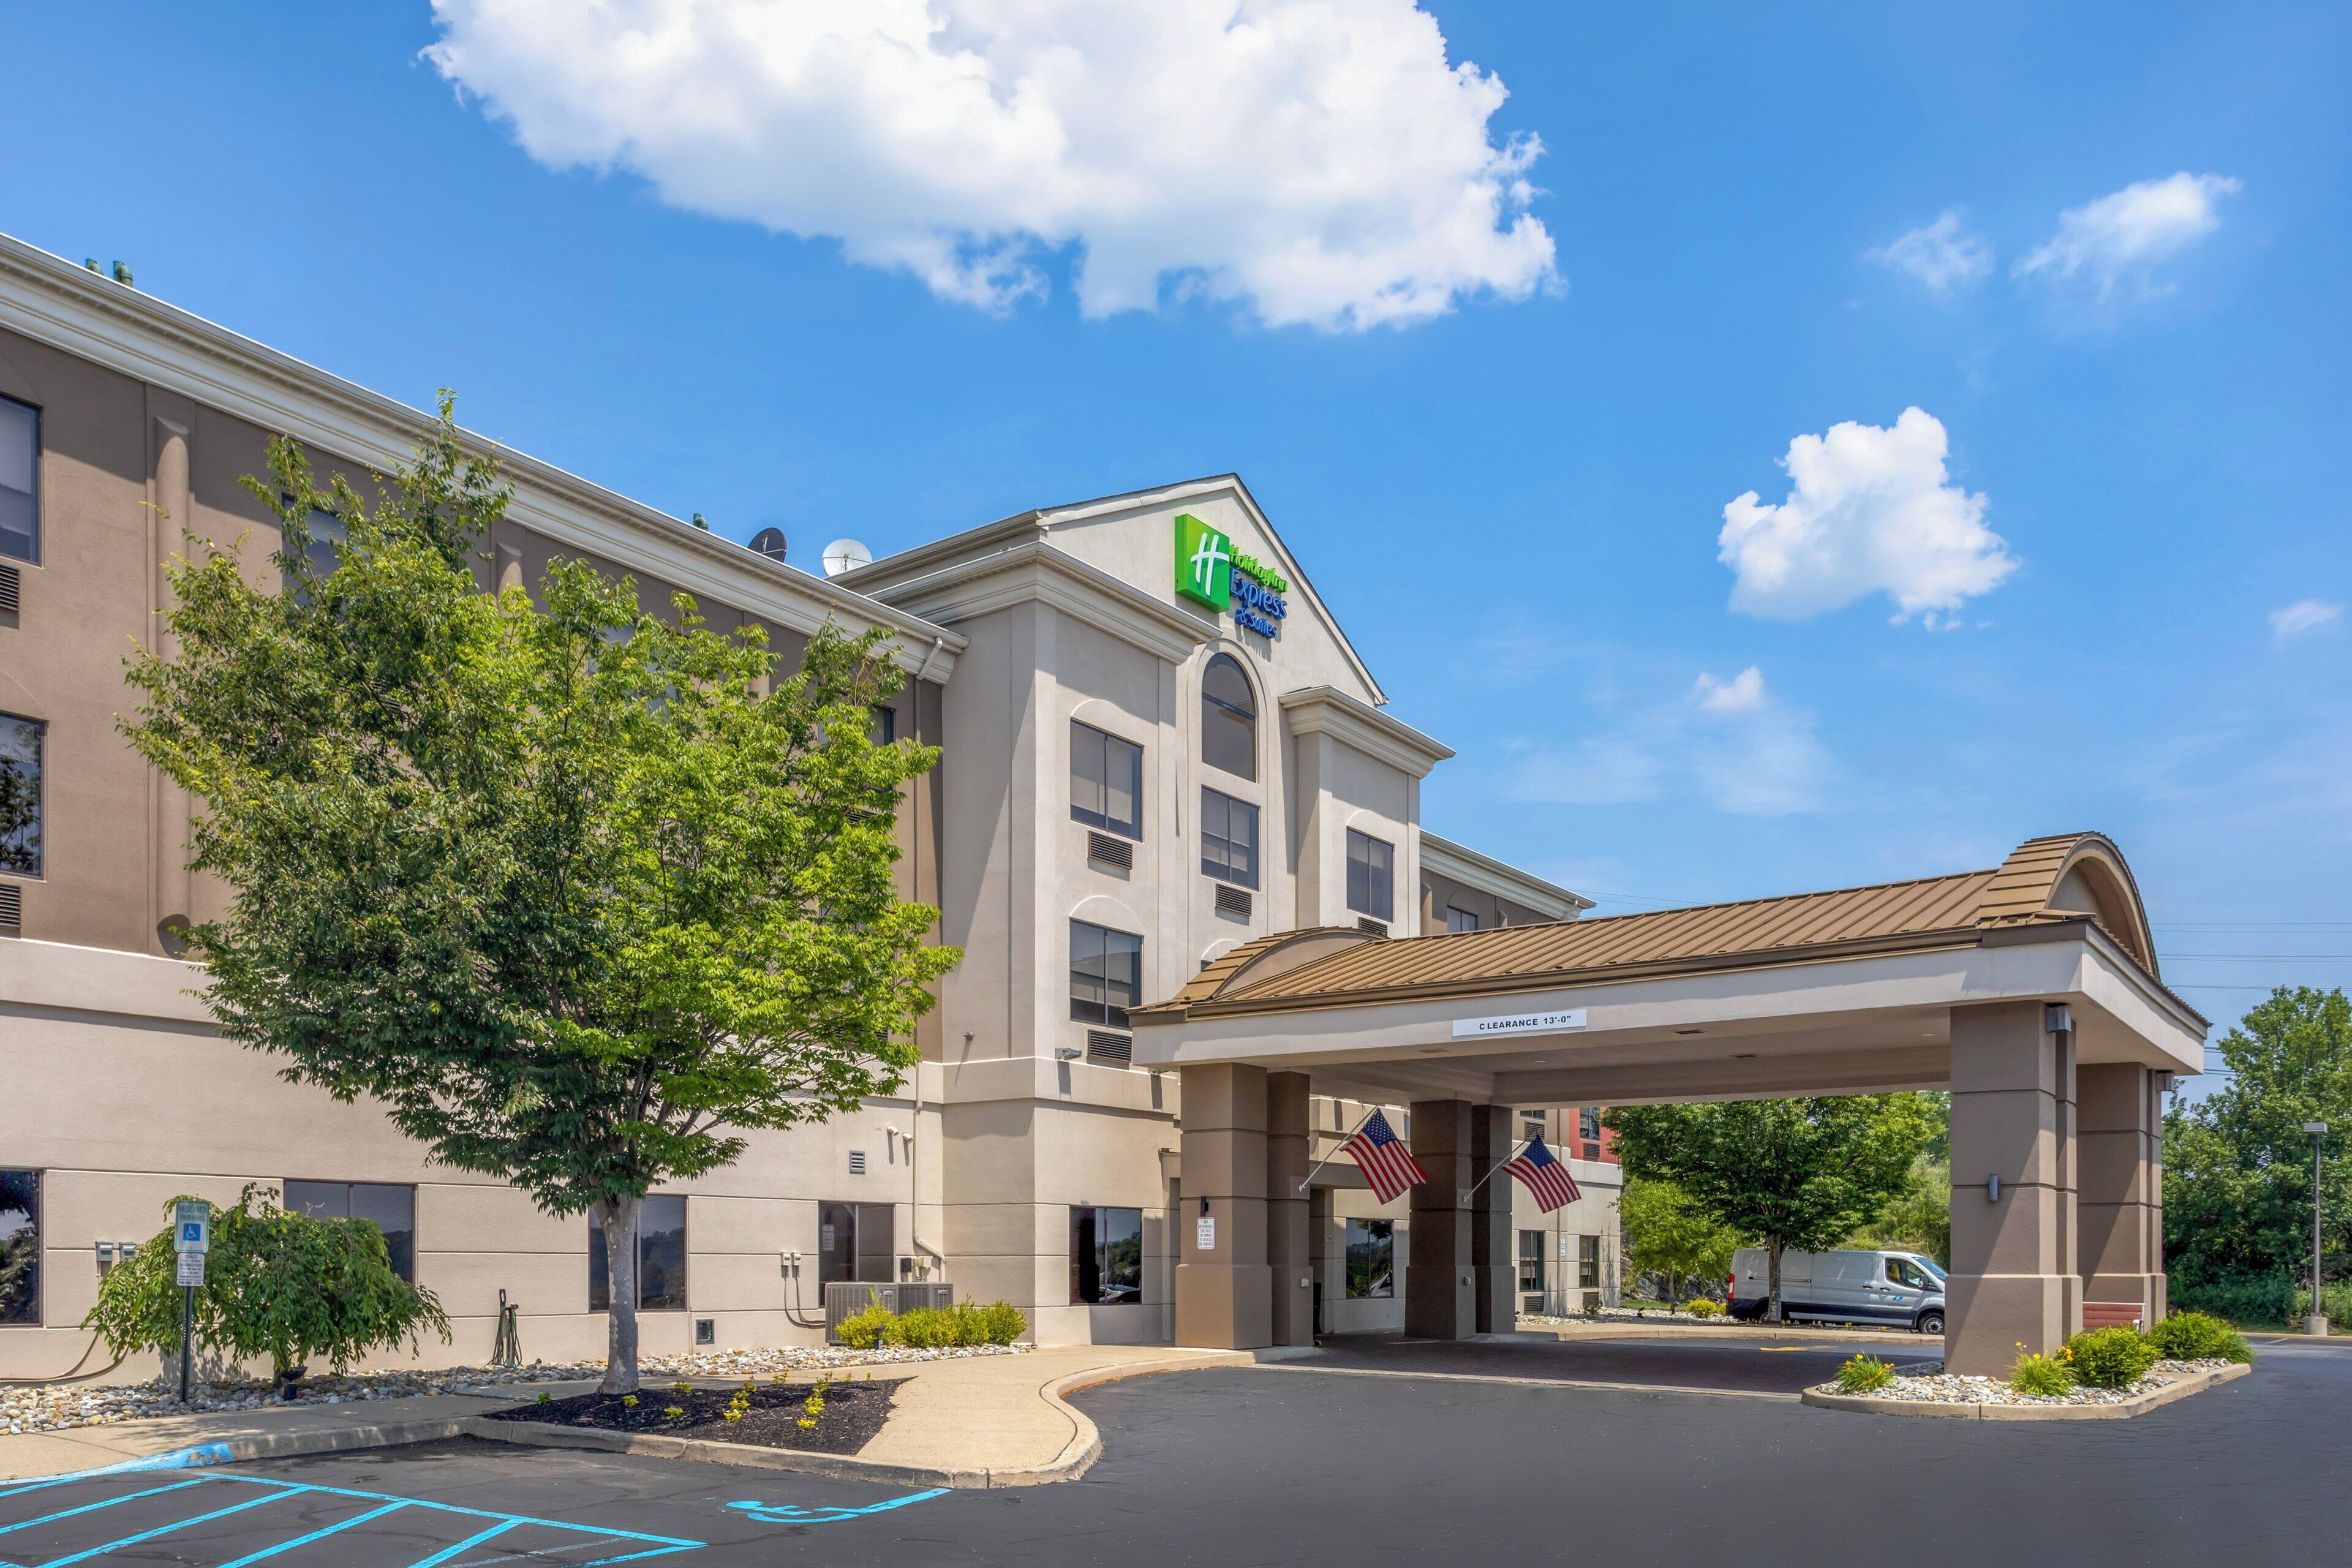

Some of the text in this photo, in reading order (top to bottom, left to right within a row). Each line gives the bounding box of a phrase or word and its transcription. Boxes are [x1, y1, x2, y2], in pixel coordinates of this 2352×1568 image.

[1229, 544, 1287, 593] Holiday Inn
[1230, 567, 1287, 620] Express
[1235, 608, 1278, 639] & Suites
[1479, 1016, 1572, 1030] CLEARANCE 13'-0"
